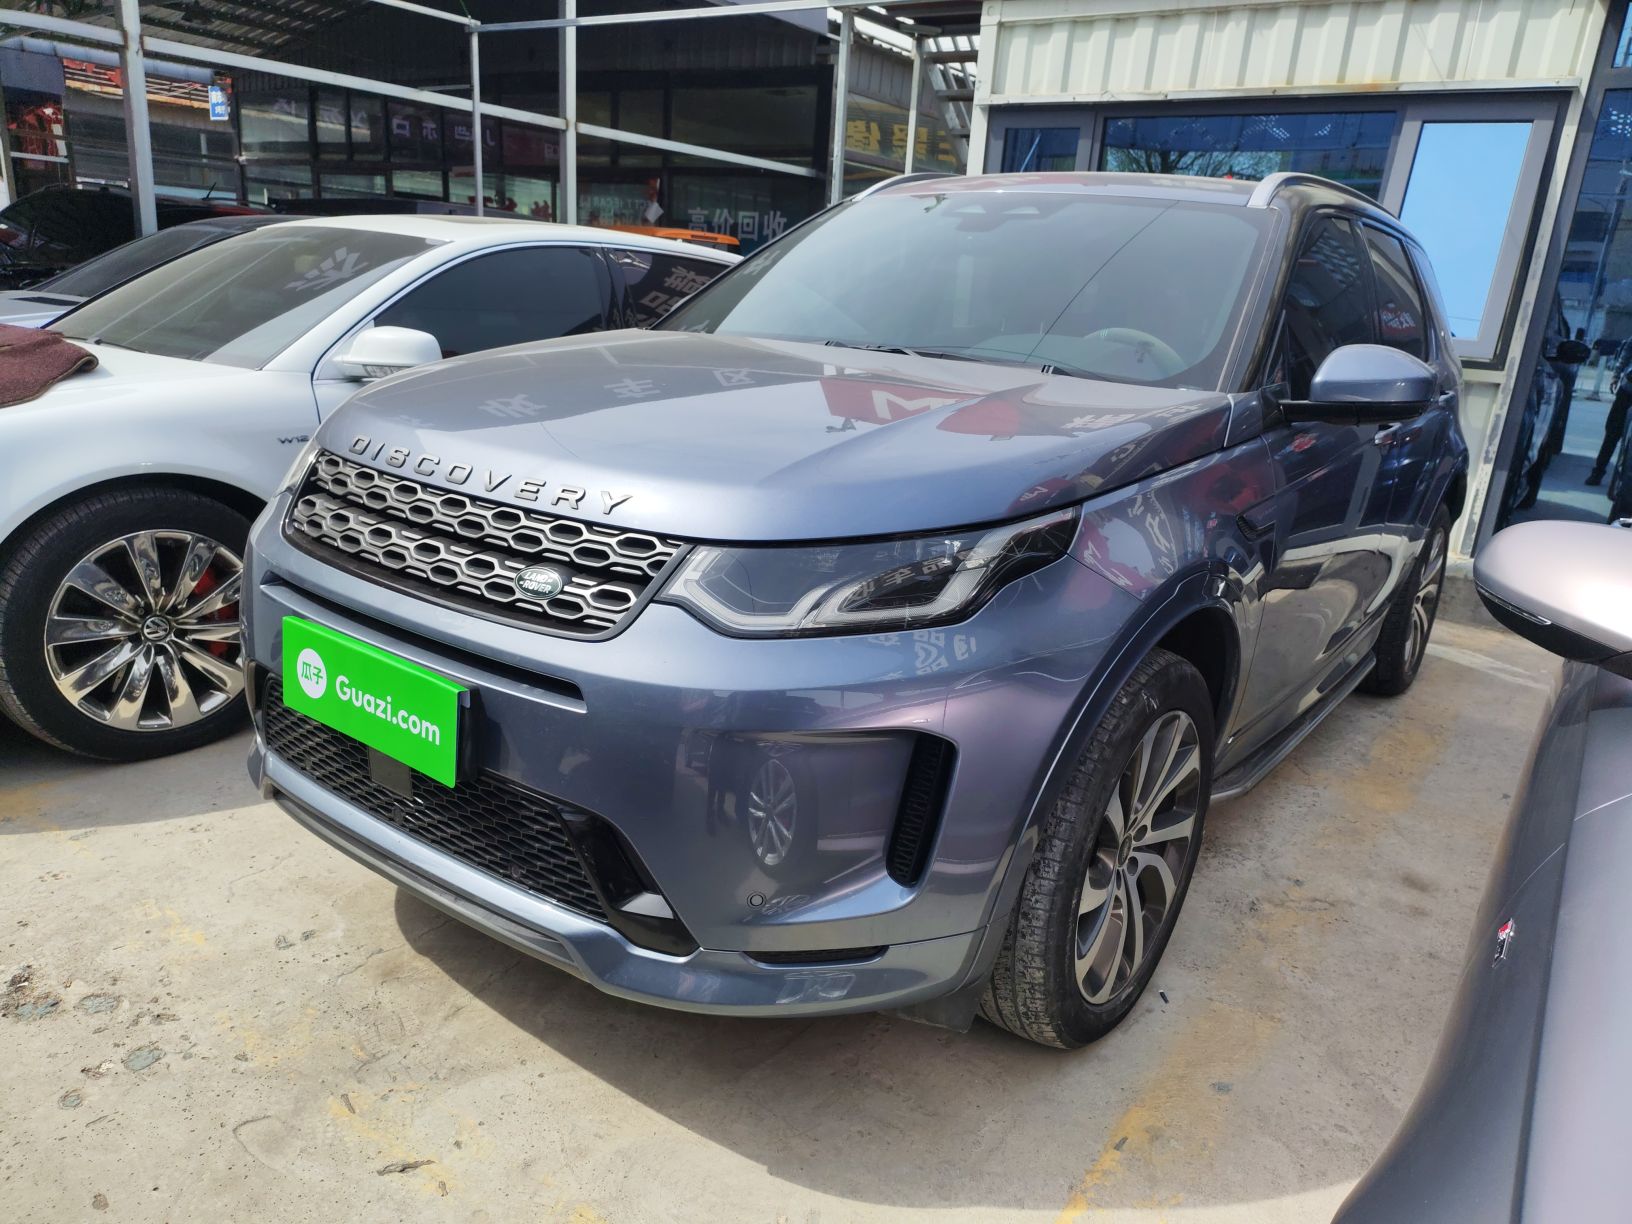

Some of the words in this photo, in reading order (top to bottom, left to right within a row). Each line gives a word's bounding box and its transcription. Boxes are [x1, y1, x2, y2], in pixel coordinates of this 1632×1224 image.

[687, 207, 787, 241] 高价回收
[350, 434, 634, 515] DISCOVERY
[522, 580, 552, 594] ROVER
[524, 571, 549, 583] LAND
[301, 661, 323, 685] 瓜子
[336, 675, 440, 746] Guazi.com
